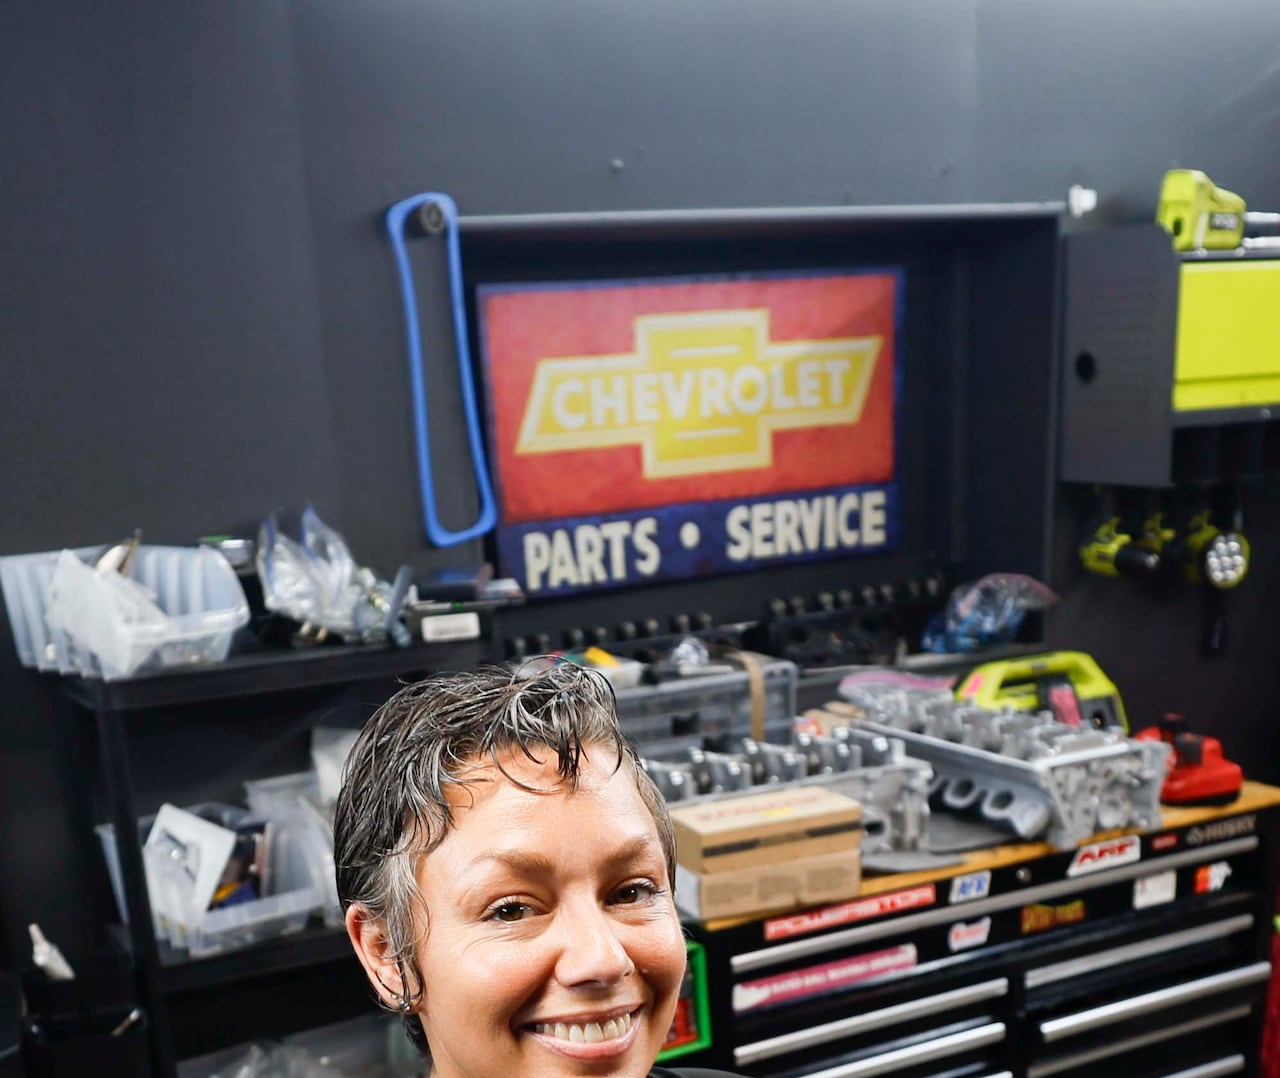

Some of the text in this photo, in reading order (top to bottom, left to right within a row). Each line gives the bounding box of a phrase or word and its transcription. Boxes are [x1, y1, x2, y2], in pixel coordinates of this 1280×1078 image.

[551, 358, 851, 428] CHEVROLET
[523, 490, 888, 592] PARTS SERVICE
